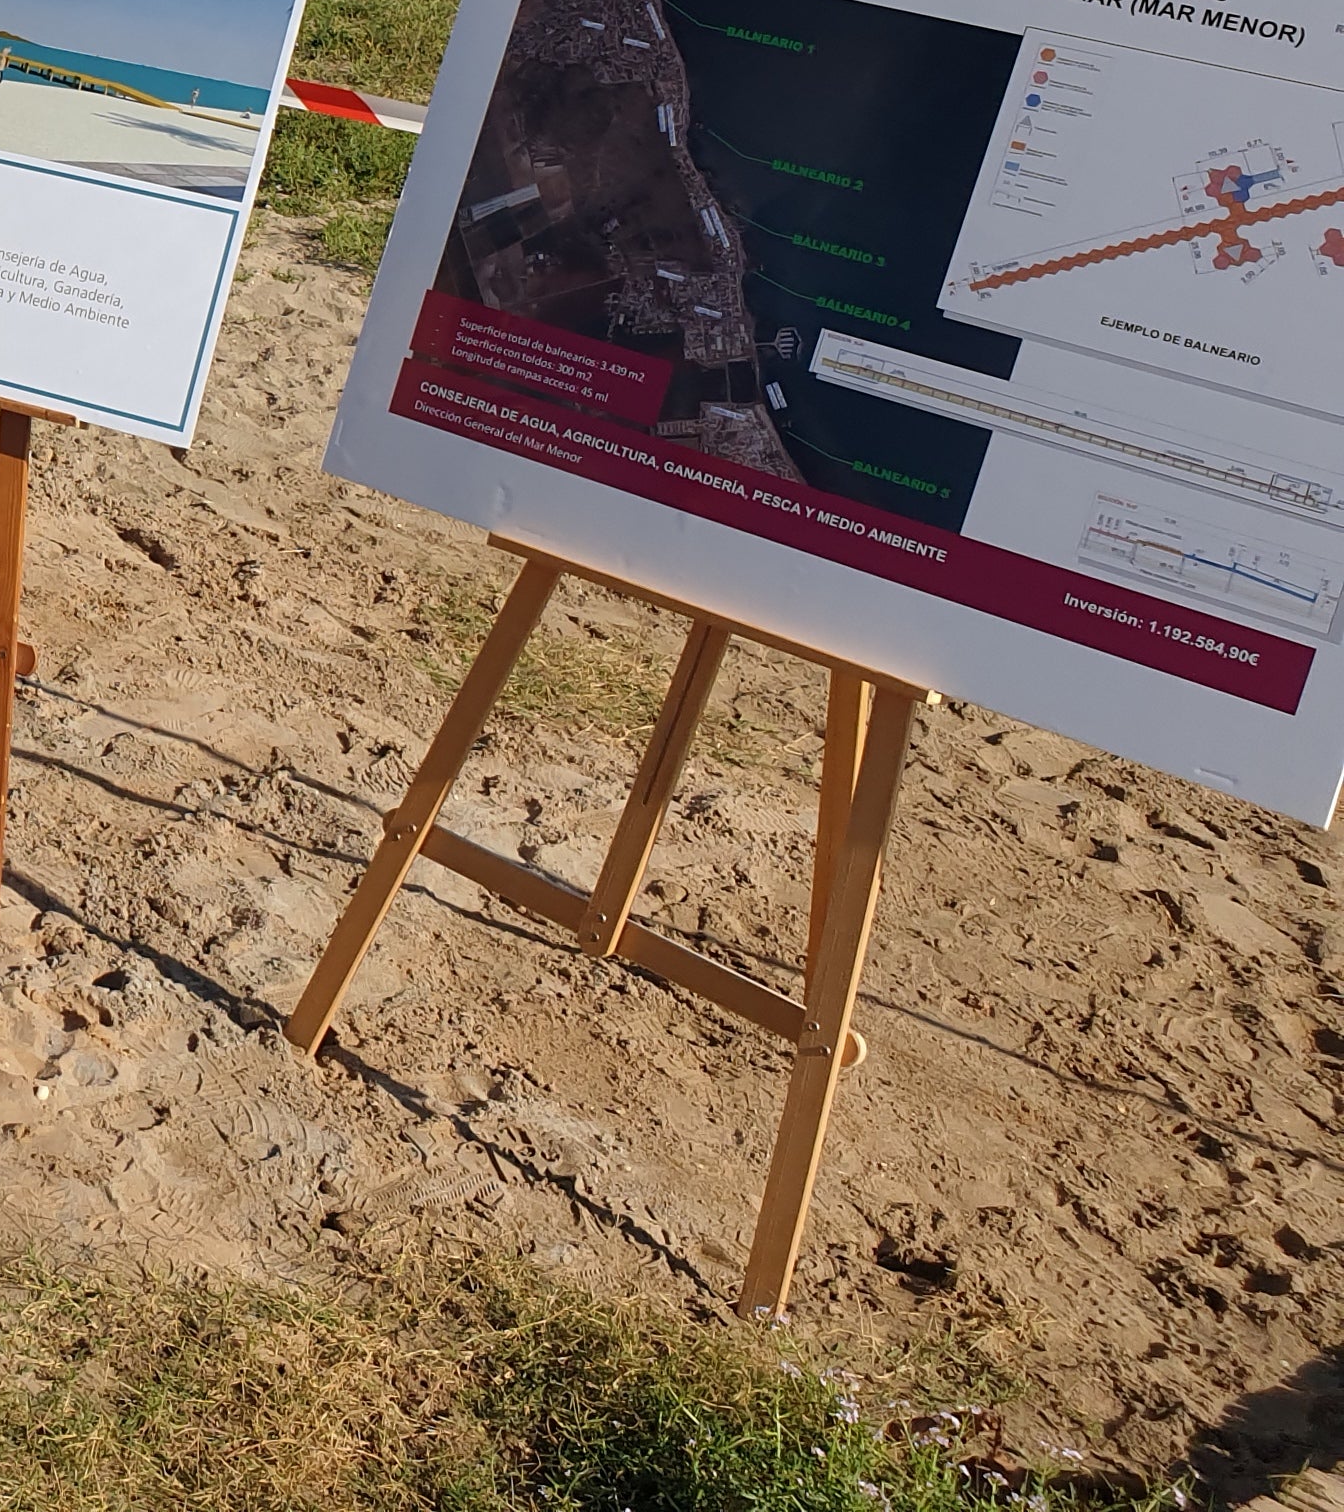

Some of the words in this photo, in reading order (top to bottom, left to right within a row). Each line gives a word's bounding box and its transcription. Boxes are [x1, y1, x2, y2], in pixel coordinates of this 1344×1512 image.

[726, 27, 803, 52] BALNEARIO
[808, 45, 815, 53] 1
[1202, 9, 1306, 48] MENOR)
[772, 159, 850, 187] BALNEARIO
[853, 180, 863, 190] 2
[792, 234, 872, 263] BALNEARIO
[877, 256, 885, 266] 3
[49, 258, 65, 274] de
[70, 264, 108, 286] Agua,
[7, 290, 16, 302] y
[18, 290, 61, 312] Medio
[63, 302, 129, 329] Ambiente
[53, 280, 124, 310] Ganadería,
[816, 297, 897, 326] BALNEARIO
[899, 320, 911, 330] 4
[456, 332, 503, 354] Superficie
[504, 346, 520, 358] con
[522, 350, 554, 370] toldos:
[557, 362, 574, 376] 300
[576, 368, 592, 382] m2
[460, 318, 508, 340] Superficie
[508, 332, 529, 348] total
[532, 339, 544, 350] de
[545, 344, 600, 368] balnearios:
[628, 369, 646, 383] m2
[1100, 316, 1160, 339] EJEMPLO
[1163, 332, 1182, 346] DE
[1184, 338, 1261, 366] BALNEARIO
[452, 346, 491, 366] Longitud
[492, 356, 506, 368] de
[507, 364, 542, 386] rampas
[543, 373, 578, 392] acceso:
[581, 386, 593, 398] 45
[594, 391, 608, 403] ml
[414, 400, 462, 424] Dirección
[464, 416, 504, 439] General
[506, 428, 522, 444] del
[524, 434, 544, 452] Mar
[546, 443, 582, 464] Menor
[420, 382, 497, 416] CONSEJERIA
[500, 406, 518, 422] DE
[520, 414, 559, 438] AGUA,
[562, 429, 660, 470] AGRICULTURA,
[664, 461, 749, 500] GANADERÍA,
[753, 490, 800, 515] PESCA
[803, 505, 815, 518] Y
[817, 510, 866, 535] MEDIO
[867, 528, 947, 563] AMBIENTE
[852, 460, 937, 494] BALNEARIO
[940, 489, 951, 498] 5
[1064, 593, 1143, 629] Inversión:
[1149, 621, 1260, 666] 1.192.584,90€
